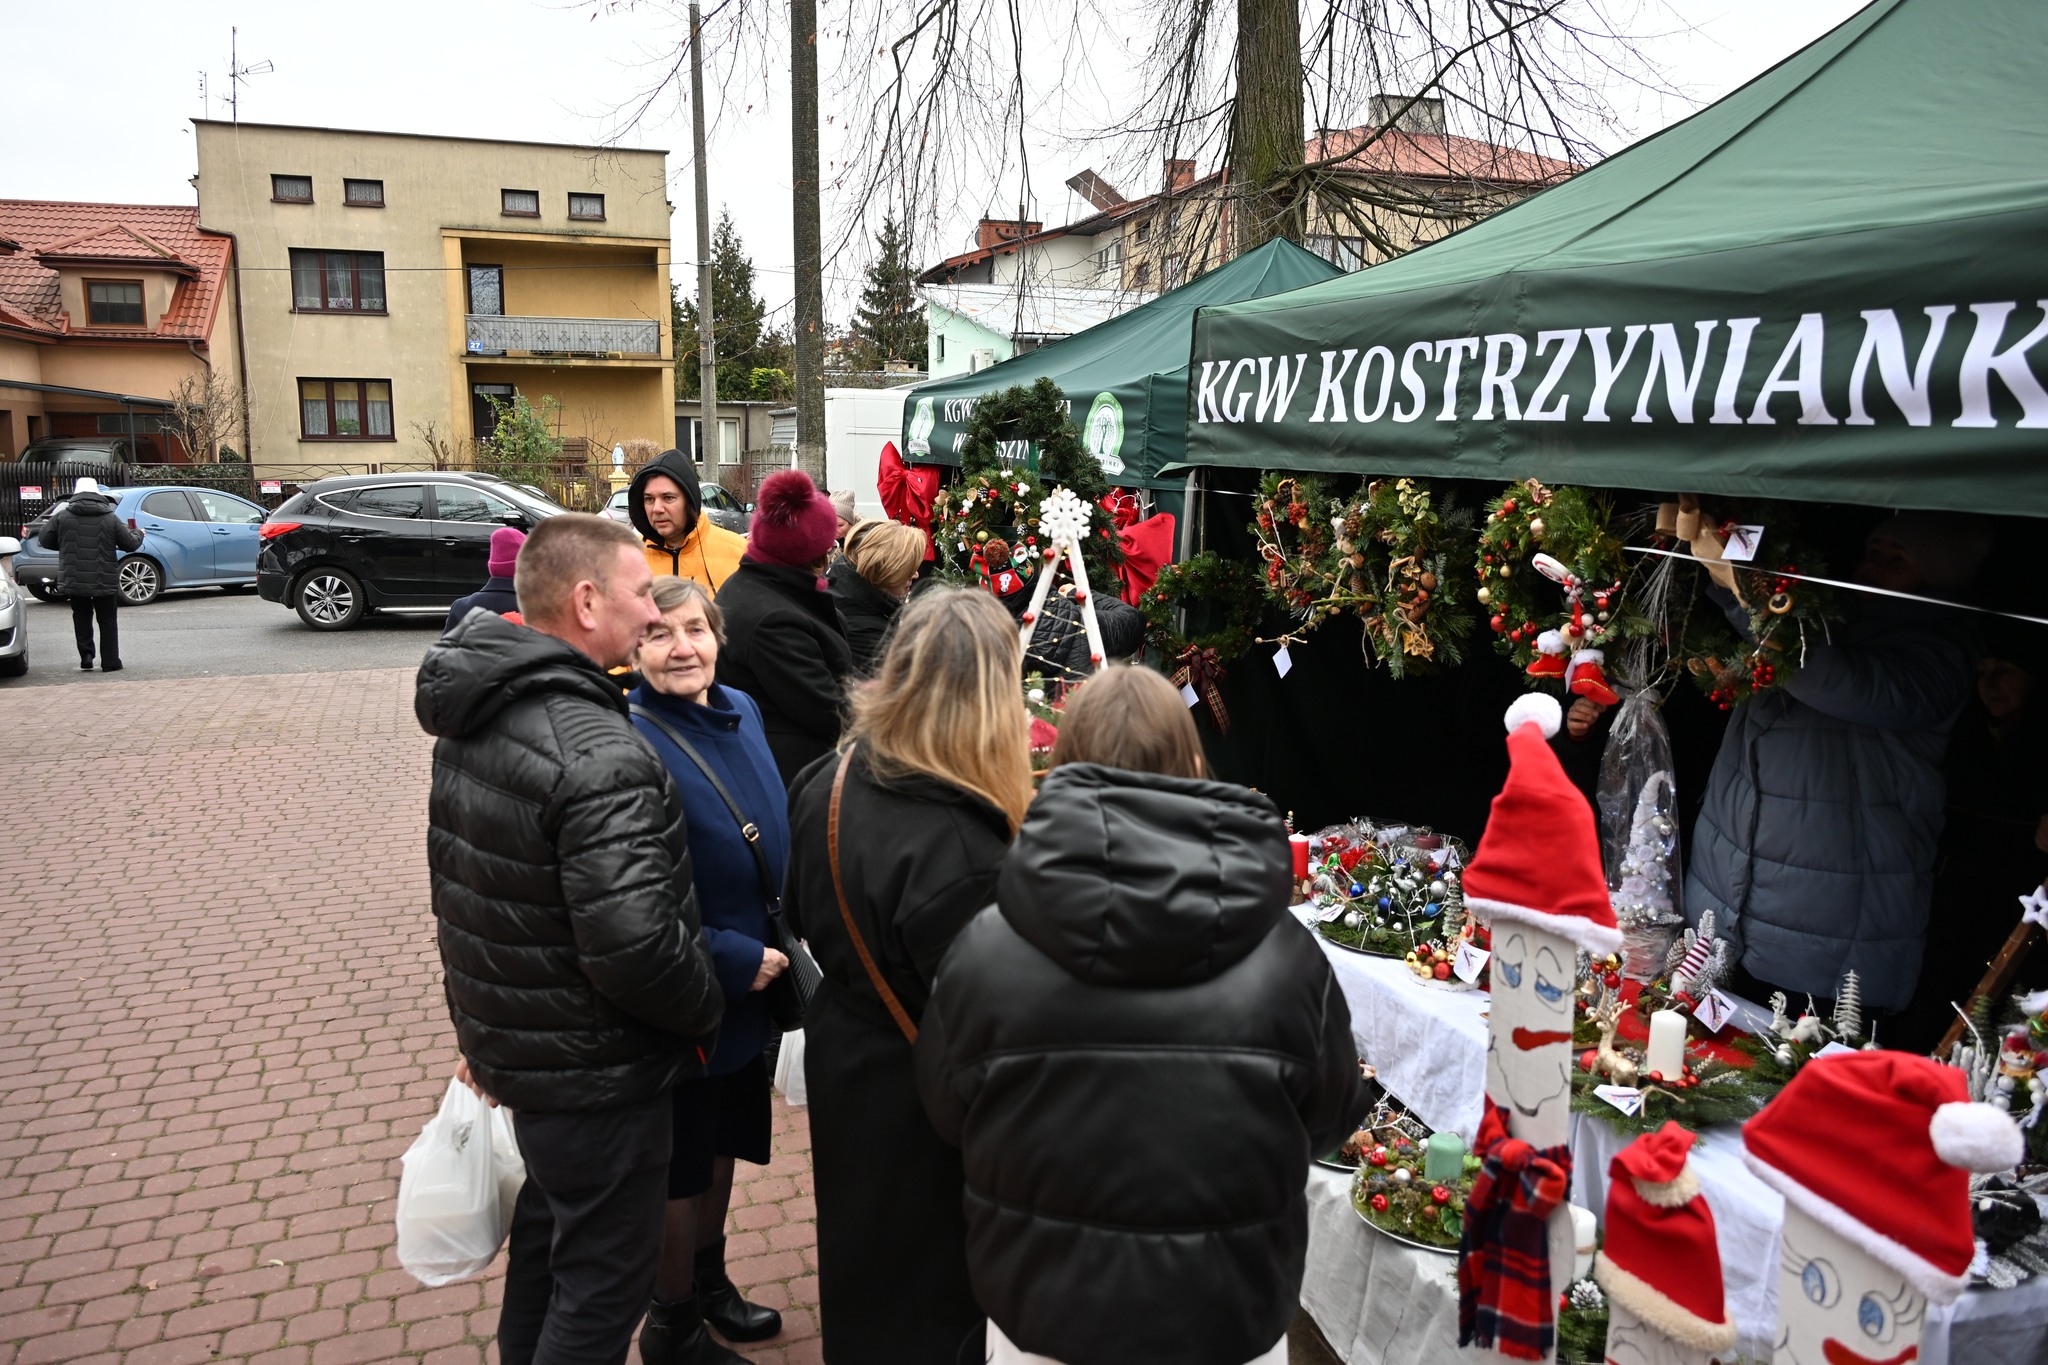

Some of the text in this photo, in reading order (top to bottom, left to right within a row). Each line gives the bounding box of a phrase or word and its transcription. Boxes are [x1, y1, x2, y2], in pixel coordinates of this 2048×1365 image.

[470, 341, 481, 349] 27
[1197, 353, 1308, 423] KGW
[1308, 299, 2048, 428] KOSTRZYNIANK
[944, 398, 977, 423] KGW
